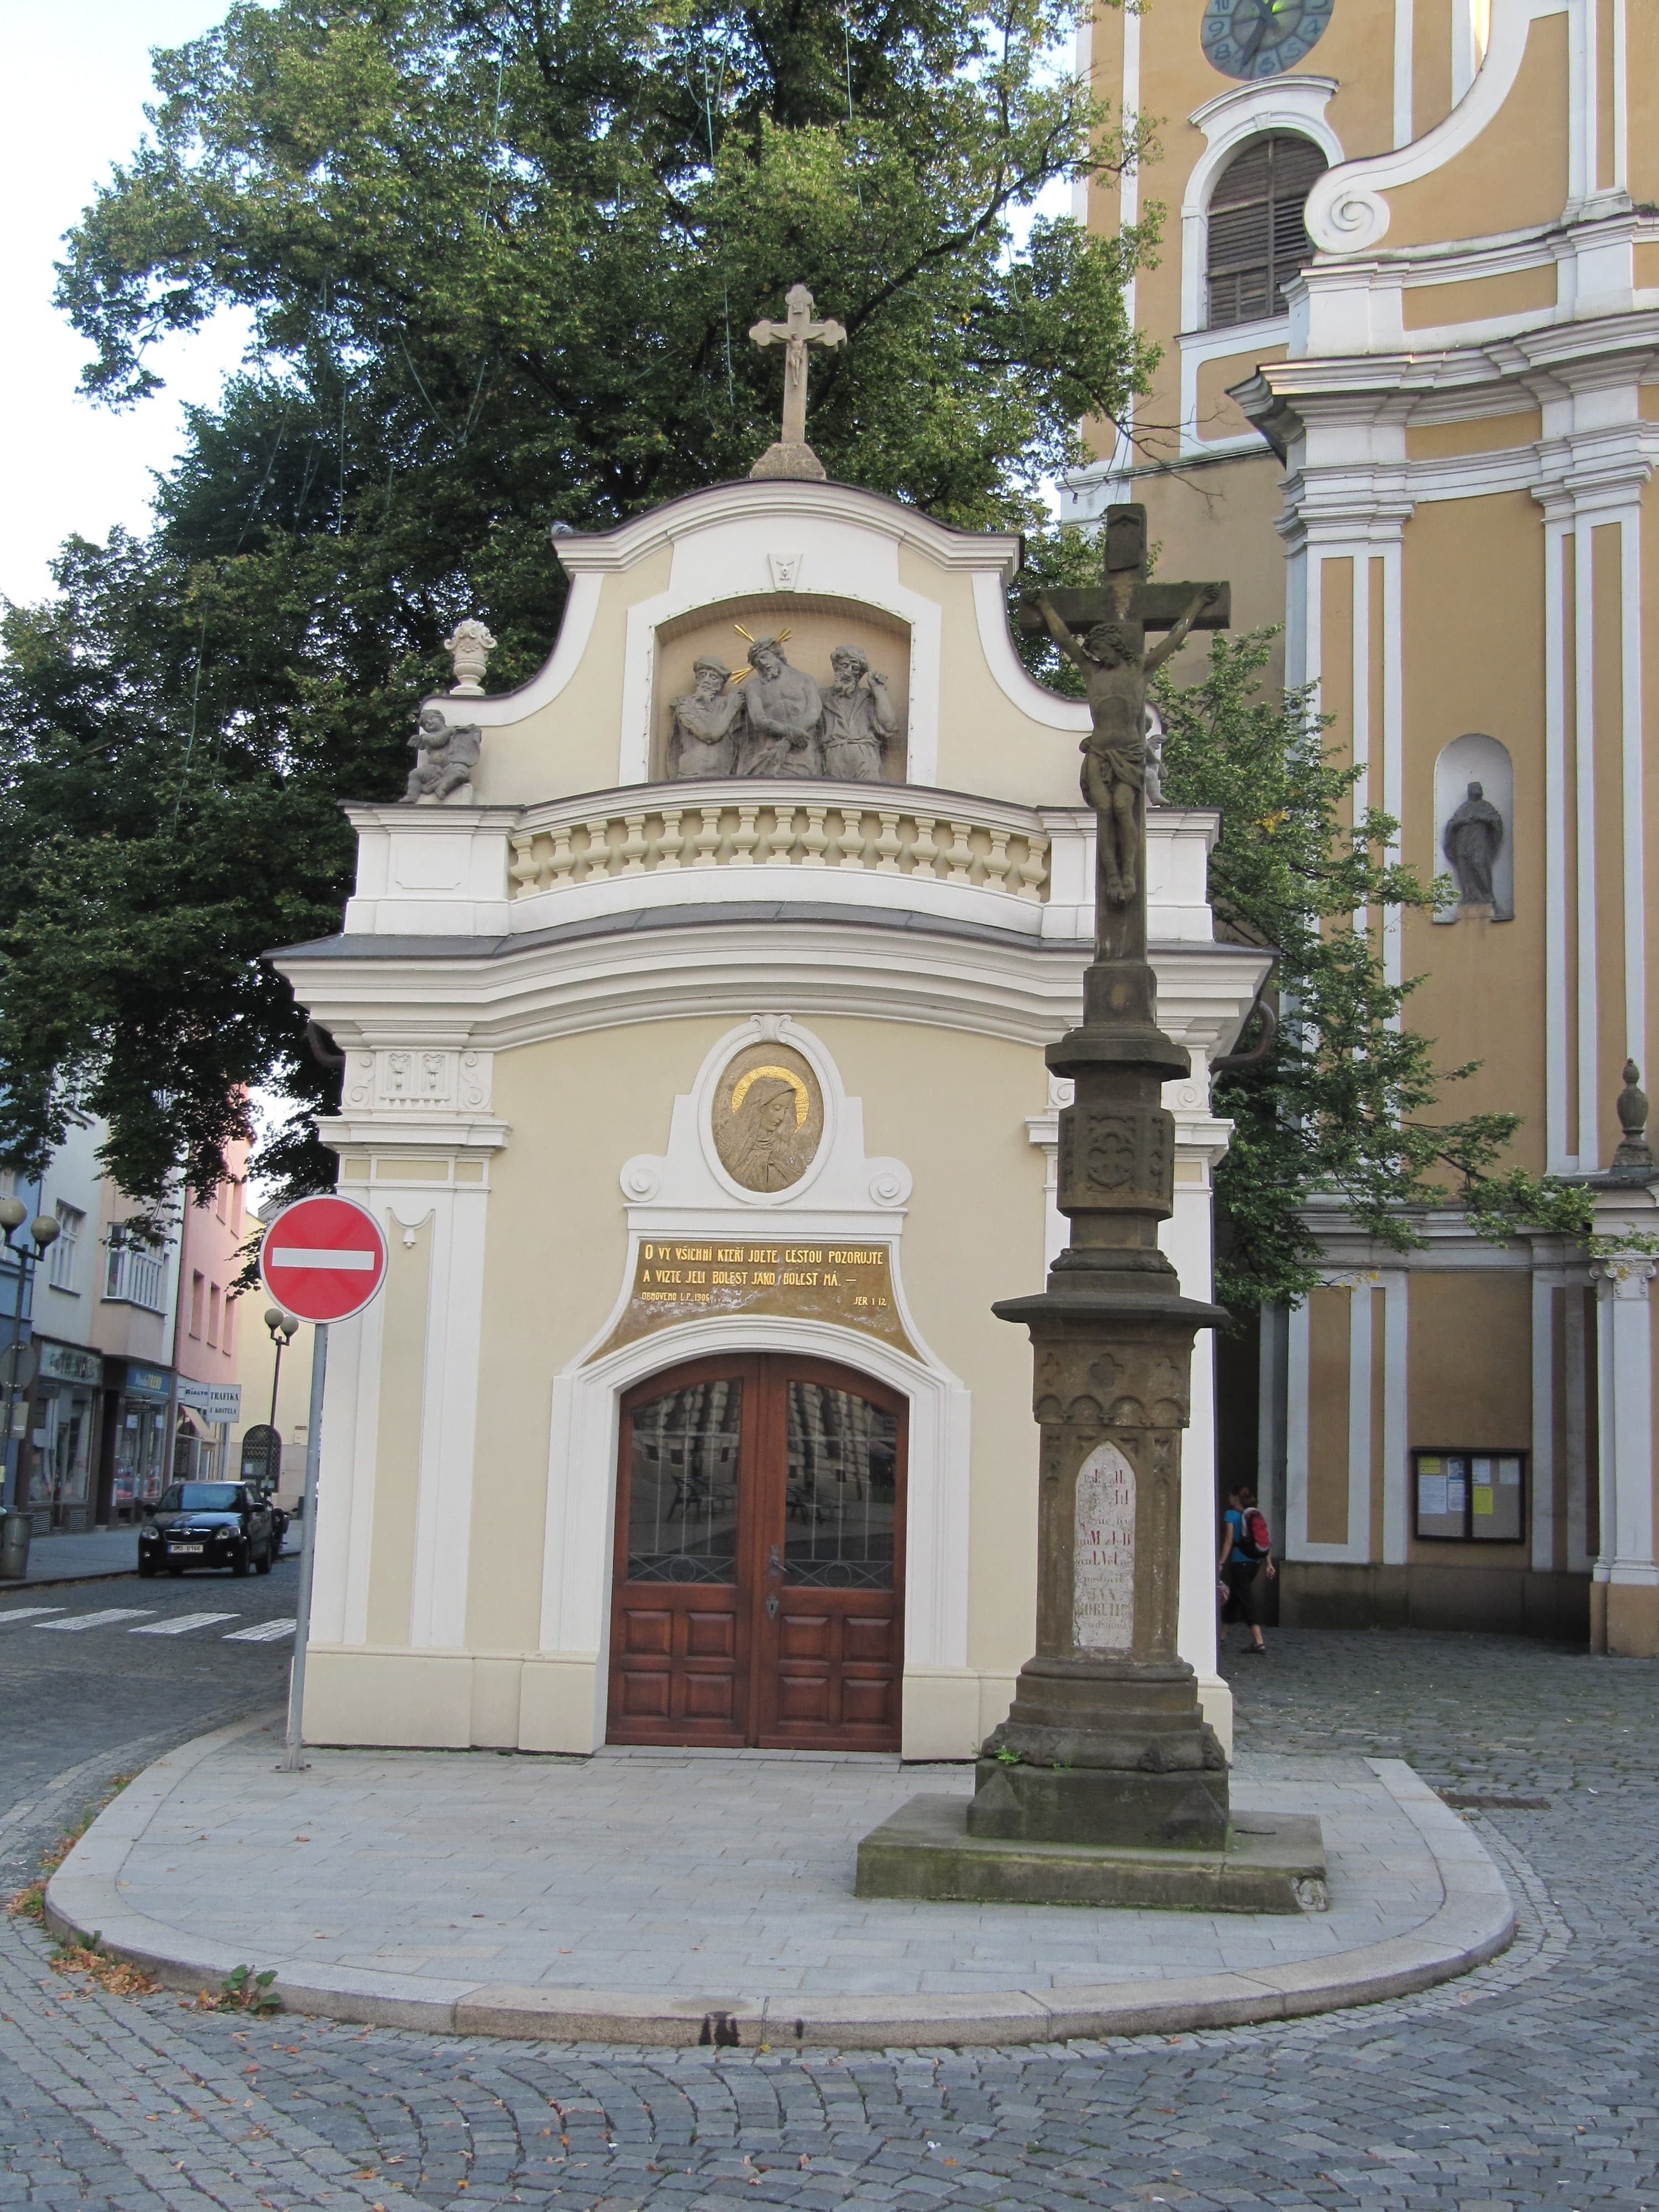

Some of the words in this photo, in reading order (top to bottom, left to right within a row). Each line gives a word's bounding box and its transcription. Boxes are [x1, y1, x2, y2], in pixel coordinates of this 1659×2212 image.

[1208, 21, 1225, 38] 9
[1303, 19, 1321, 35] 4
[1214, 43, 1230, 60] 8
[1284, 42, 1301, 59] 5
[1258, 56, 1275, 74] 6
[645, 1244, 653, 1260] O
[659, 1247, 671, 1260] VY
[718, 1247, 744, 1262] KTEŘÍ
[748, 1249, 778, 1263] JDETE
[785, 1250, 822, 1264] CESTOU
[828, 1251, 883, 1265] POZORUJTE
[643, 1270, 651, 1282] A
[656, 1270, 681, 1284] VIZTE
[686, 1271, 706, 1284] JELI
[712, 1271, 748, 1285] BOLEST
[751, 1272, 775, 1285] JAKO
[783, 1272, 818, 1286] BOLEST
[695, 1293, 710, 1302] 1906
[854, 1296, 868, 1305] JER
[210, 1392, 238, 1401] TRAFIKA
